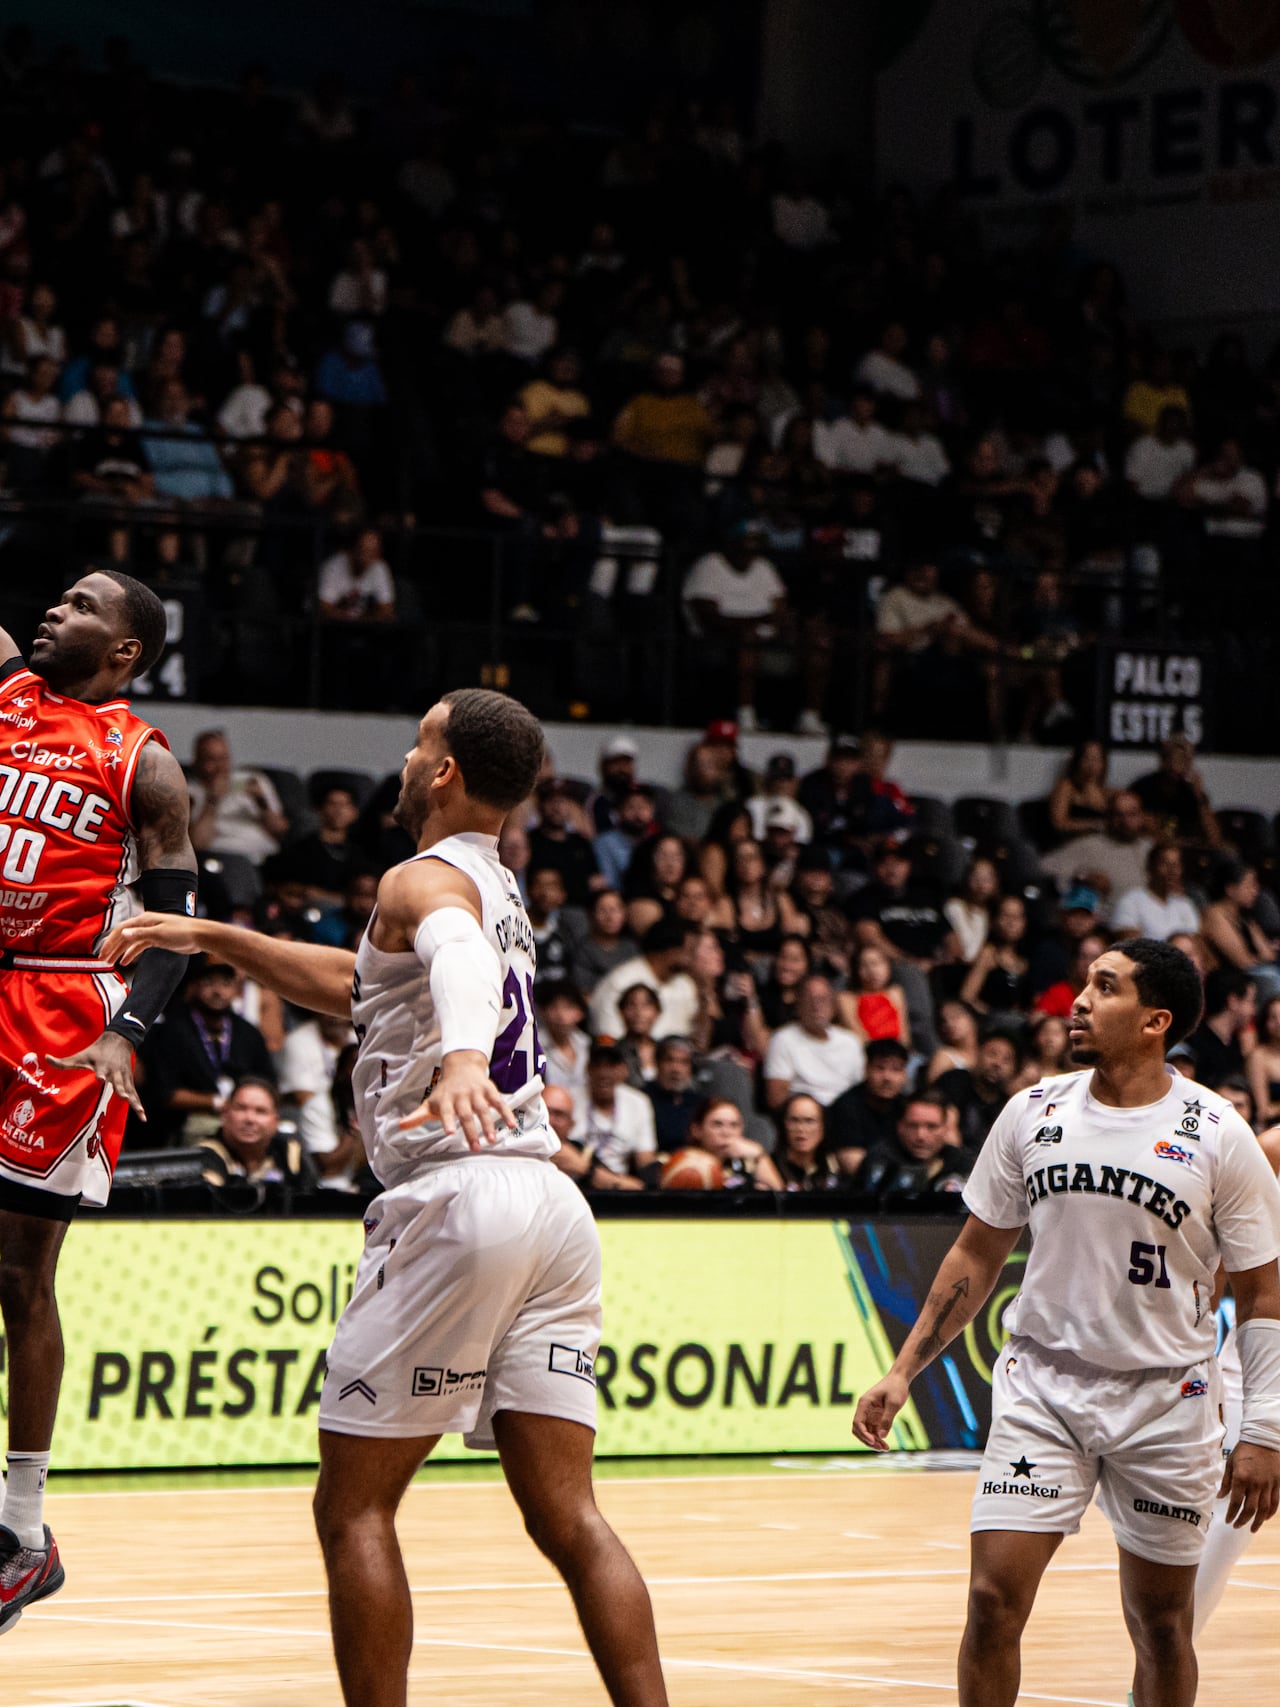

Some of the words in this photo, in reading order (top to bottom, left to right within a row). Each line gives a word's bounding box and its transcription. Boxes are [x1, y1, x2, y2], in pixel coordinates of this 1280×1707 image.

[10, 741, 72, 771] Claro
[2, 1119, 45, 1149] LTERÍA
[1026, 1163, 1192, 1229] GIGANTES
[1128, 1240, 1171, 1289] 51
[253, 1265, 353, 1325] Soli
[87, 1326, 328, 1421] PRÉSTA
[596, 1343, 857, 1408] RSONAL
[982, 1481, 1059, 1499] Heineken
[1133, 1498, 1202, 1527] GIGANTES
